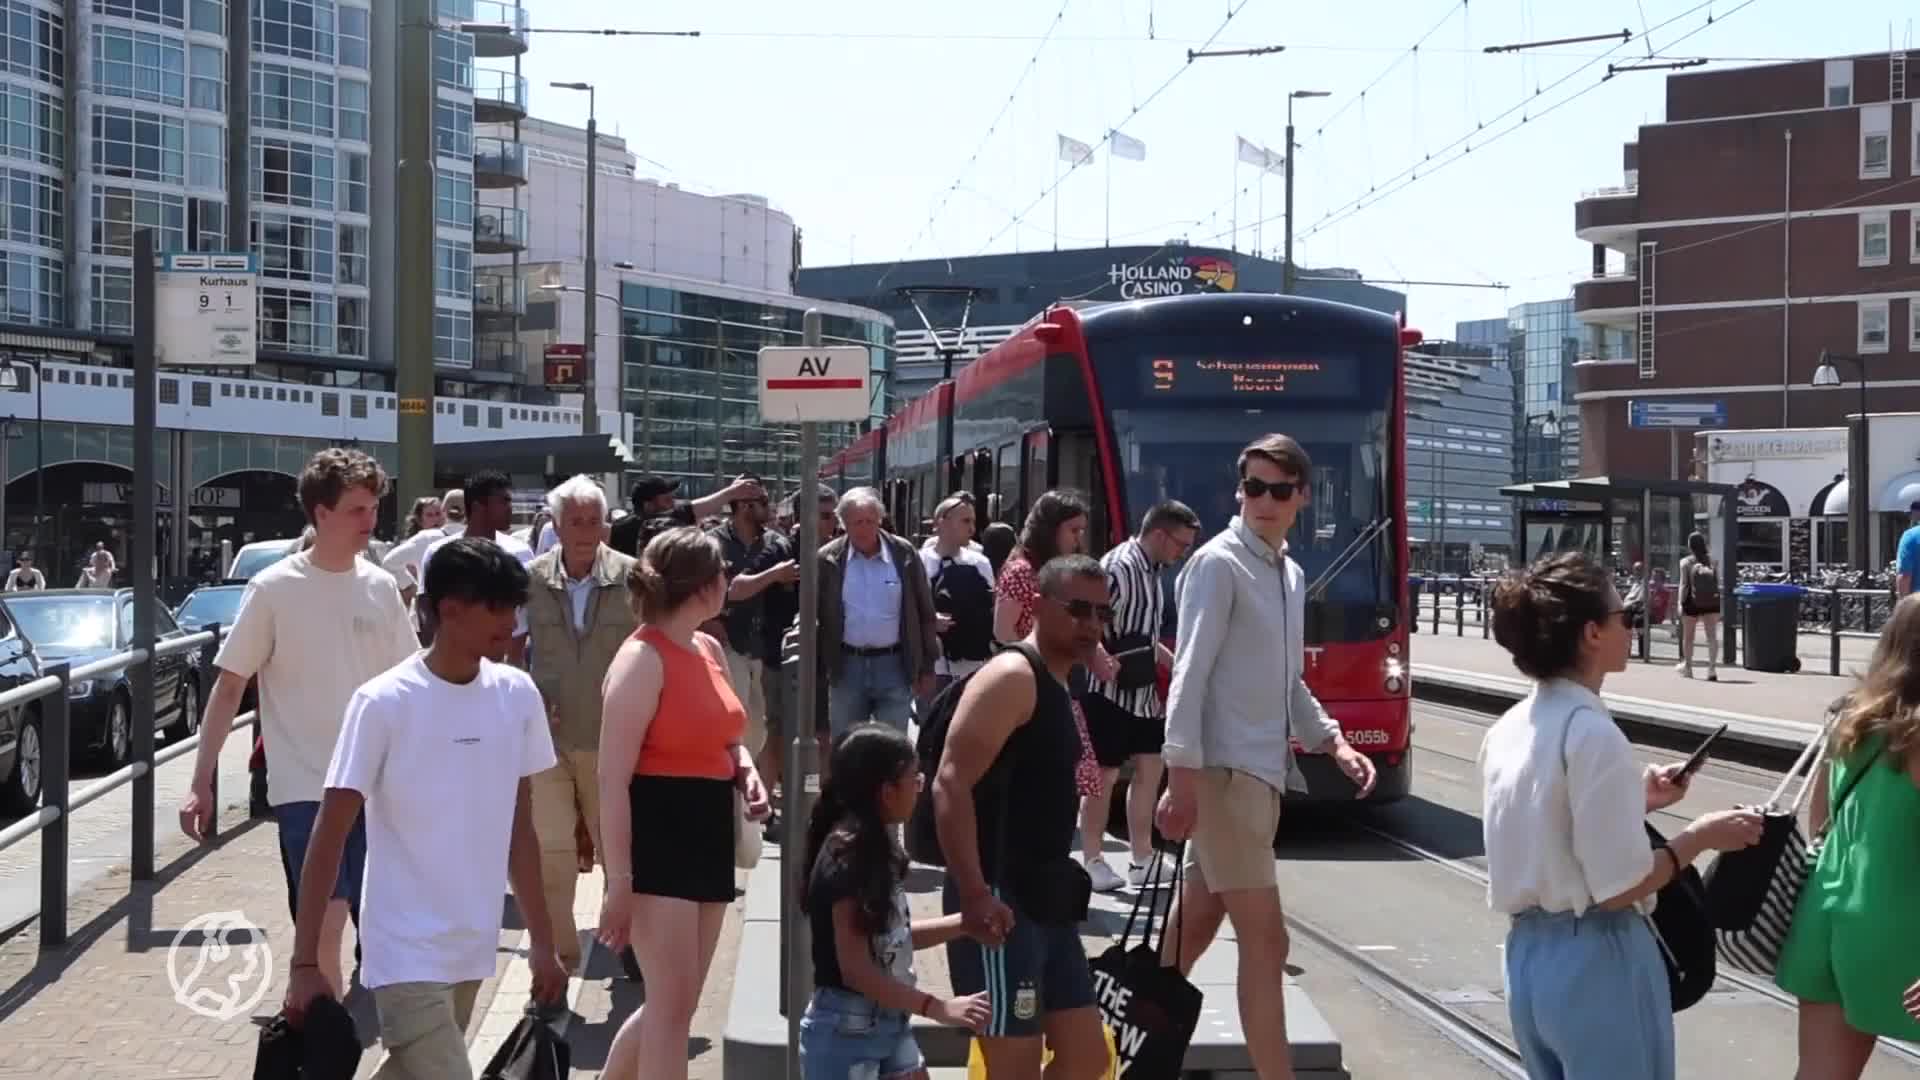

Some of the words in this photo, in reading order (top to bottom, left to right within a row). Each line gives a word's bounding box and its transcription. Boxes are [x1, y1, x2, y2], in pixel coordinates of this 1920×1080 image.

[199, 275, 249, 287] Kurhaus
[1107, 263, 1192, 285] HOLLAND
[1120, 280, 1183, 300] CASINO
[199, 295, 209, 308] 9
[225, 295, 232, 307] 1
[798, 357, 831, 376] AV
[190, 487, 225, 505] HOP
[1345, 728, 1389, 744] 5055b
[1093, 969, 1133, 1018] THE
